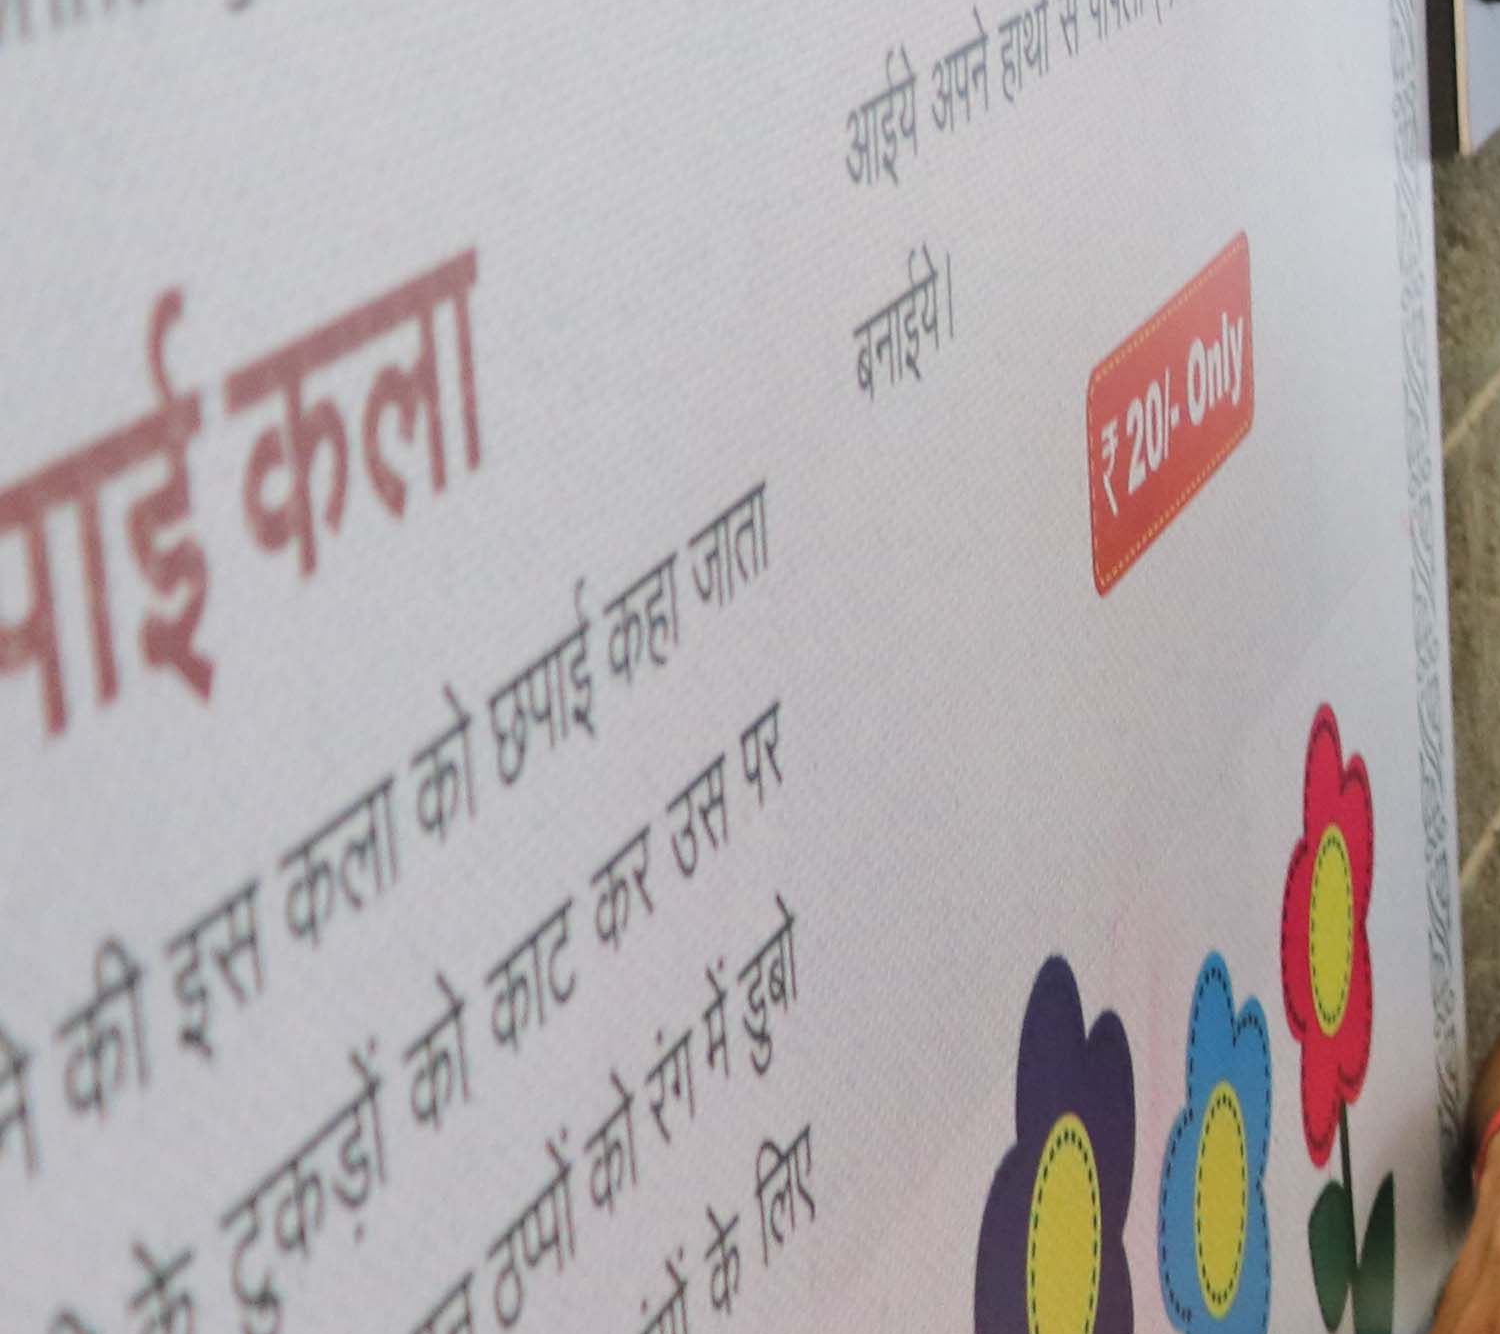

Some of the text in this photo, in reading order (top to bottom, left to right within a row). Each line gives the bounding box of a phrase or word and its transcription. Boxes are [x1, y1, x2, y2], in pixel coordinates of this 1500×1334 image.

[846, 42, 918, 187] आईये
[931, 4, 990, 133] अपने
[223, 245, 481, 579] कला
[1126, 366, 1180, 495] 20/-
[1186, 311, 1245, 426] Only
[54, 931, 149, 1126] की
[161, 880, 268, 1065] इस
[277, 770, 402, 952] कला
[409, 679, 479, 845] को
[487, 575, 597, 787] छपाई
[603, 551, 680, 686] कहा
[687, 479, 769, 607] जाता
[401, 970, 472, 1135] को
[485, 895, 577, 1053] काट
[590, 822, 655, 952] कर
[666, 750, 730, 880] उस
[740, 698, 783, 810] पर
[485, 1127, 577, 1330] ठप्पों
[583, 1069, 638, 1216] को
[644, 1027, 695, 1146] रंग
[702, 956, 729, 1080] में
[738, 890, 797, 1078] डुबो
[704, 1204, 741, 1316] के
[753, 1123, 816, 1269] लिए
